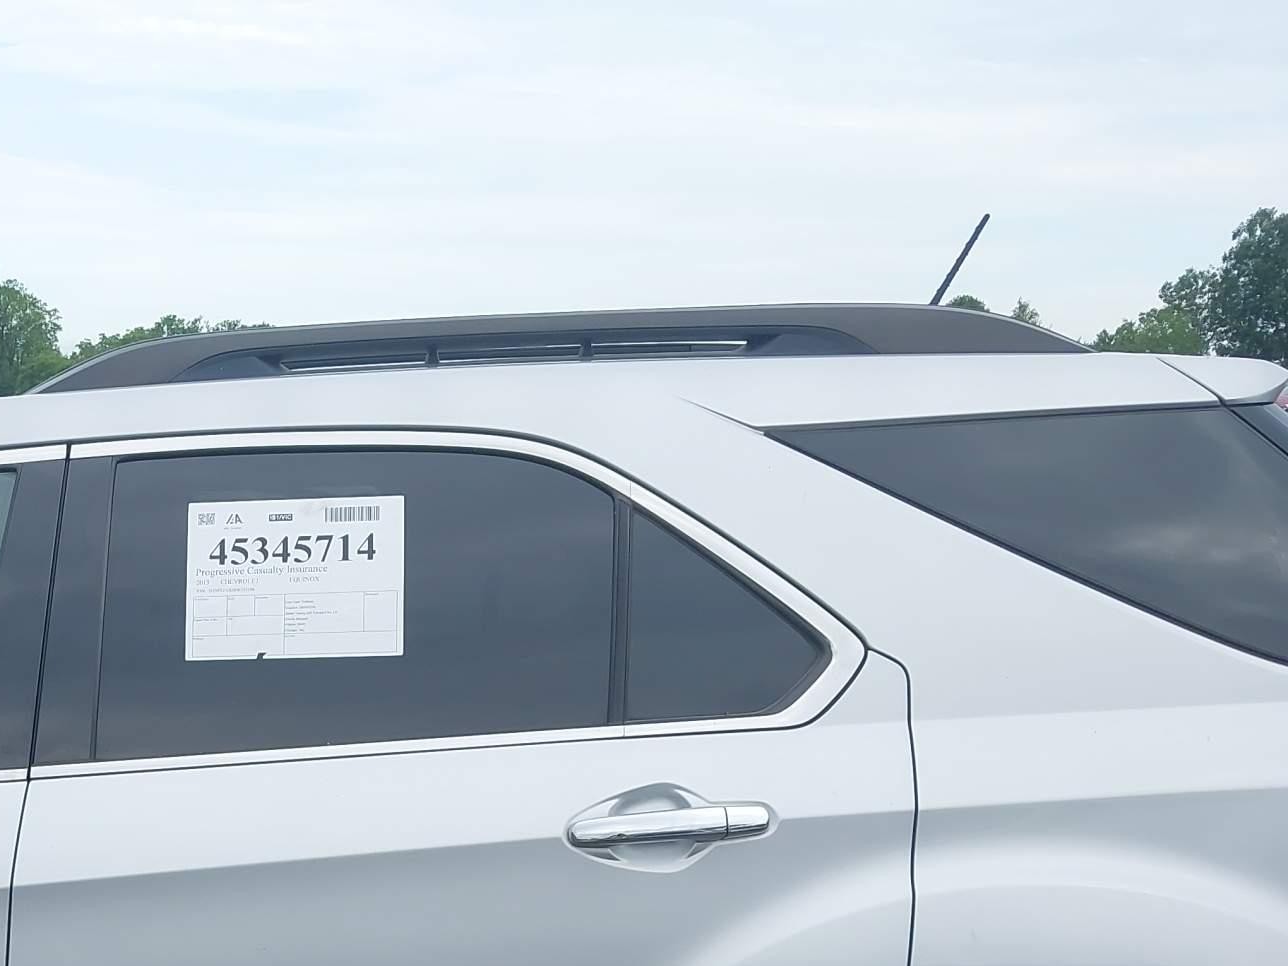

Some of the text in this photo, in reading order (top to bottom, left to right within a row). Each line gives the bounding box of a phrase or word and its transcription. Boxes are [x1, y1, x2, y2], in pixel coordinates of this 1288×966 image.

[209, 533, 376, 565] 45345714
[195, 565, 328, 578] Progressive Casualty Insurance
